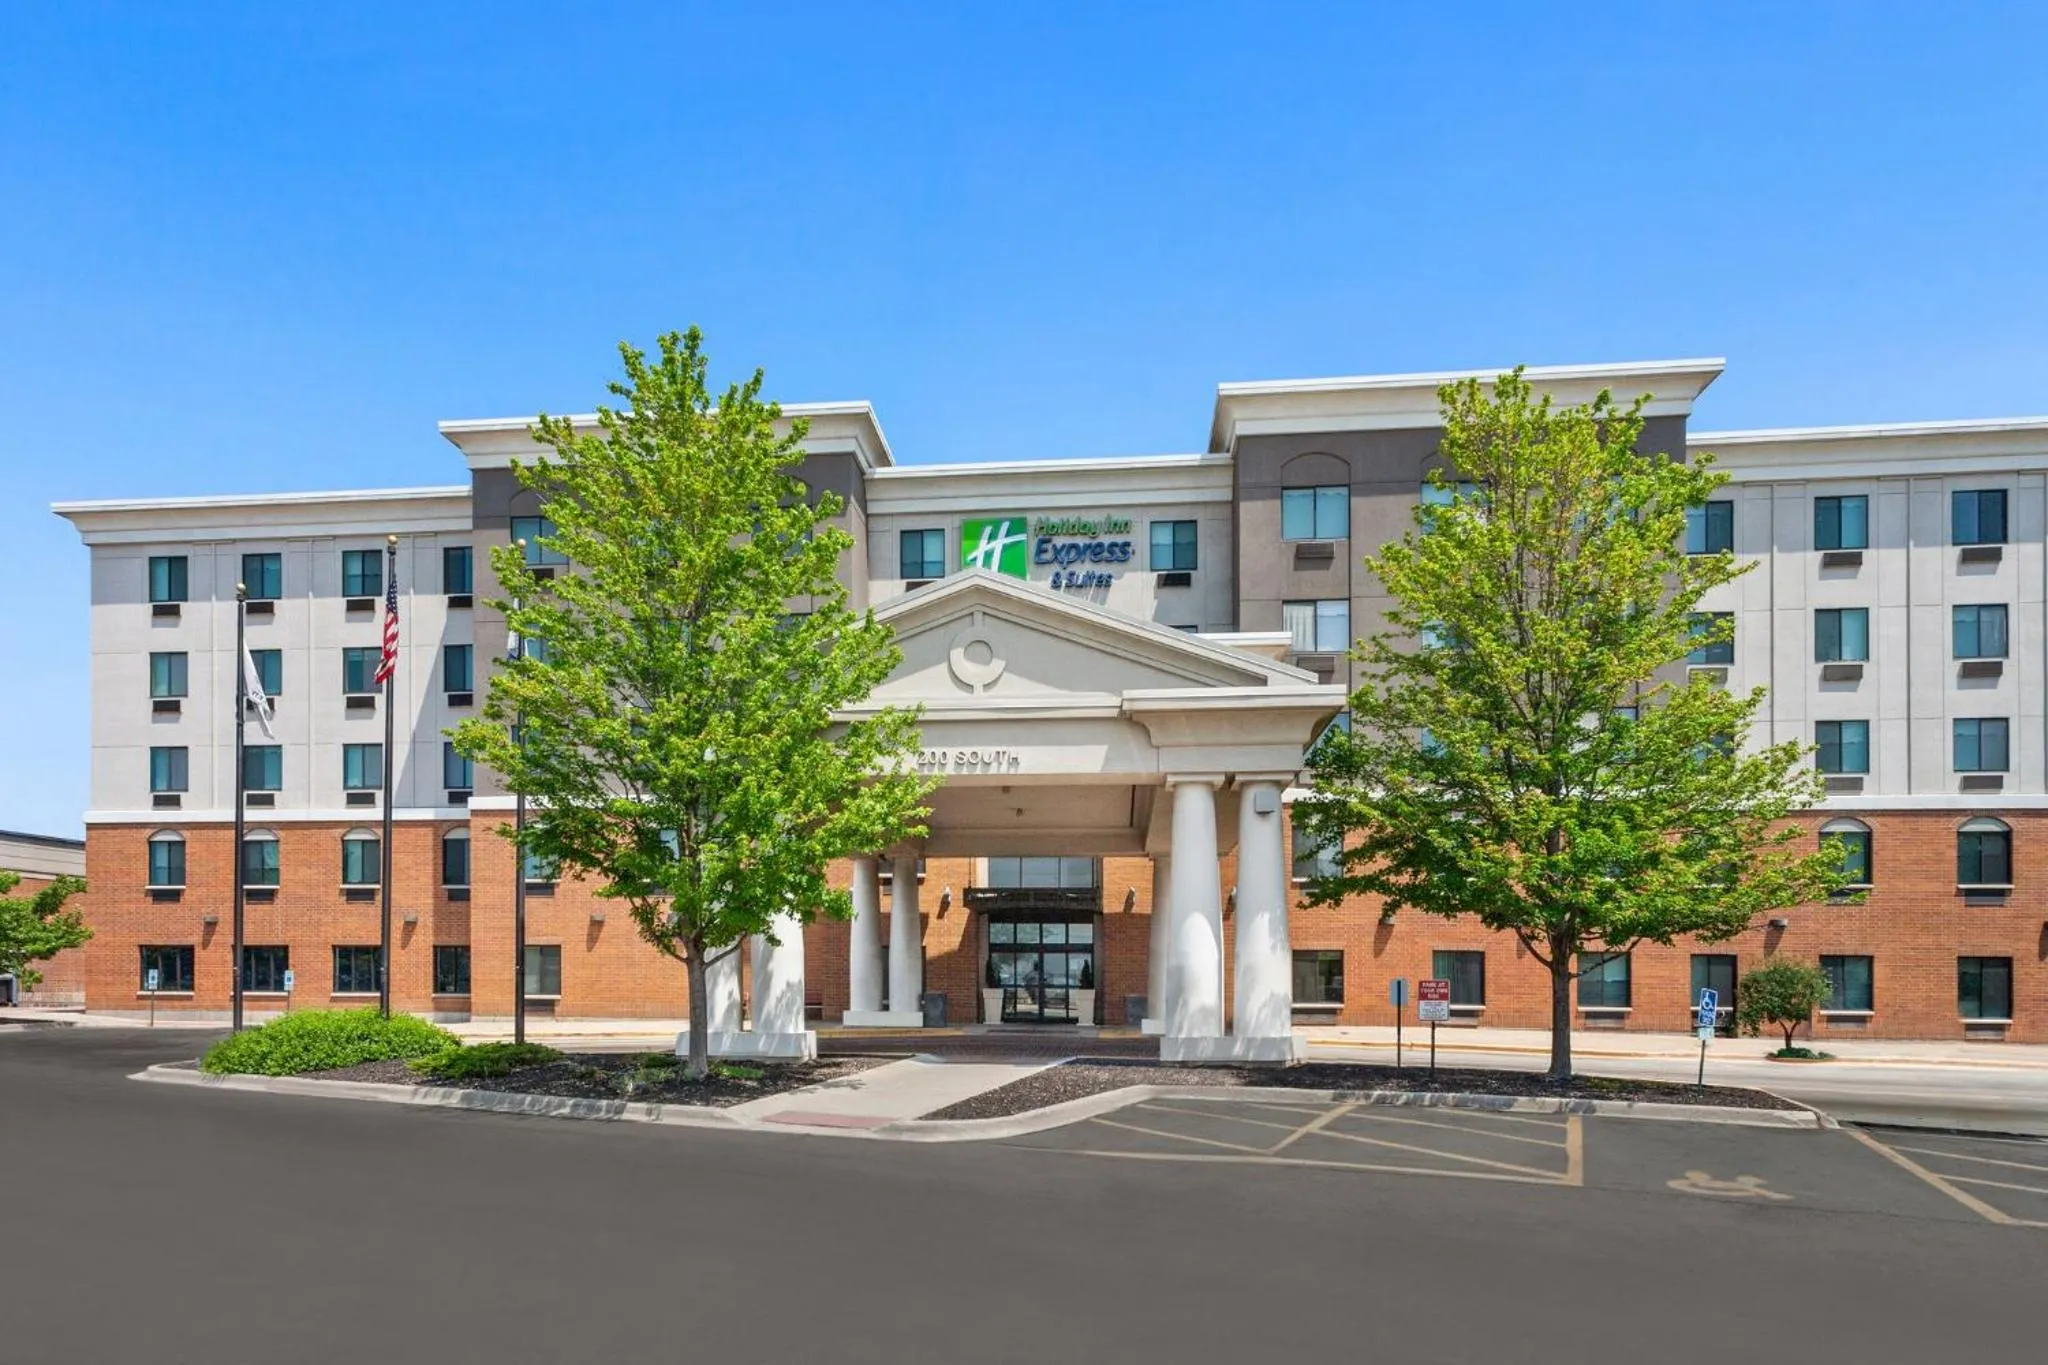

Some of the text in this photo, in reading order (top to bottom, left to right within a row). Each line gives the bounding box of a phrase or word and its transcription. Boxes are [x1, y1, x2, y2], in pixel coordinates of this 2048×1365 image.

[1034, 514, 1132, 538] Holiday Inn
[1034, 537, 1132, 568] Express
[1051, 570, 1113, 589] & Suites
[954, 751, 1020, 765] SOUTH
